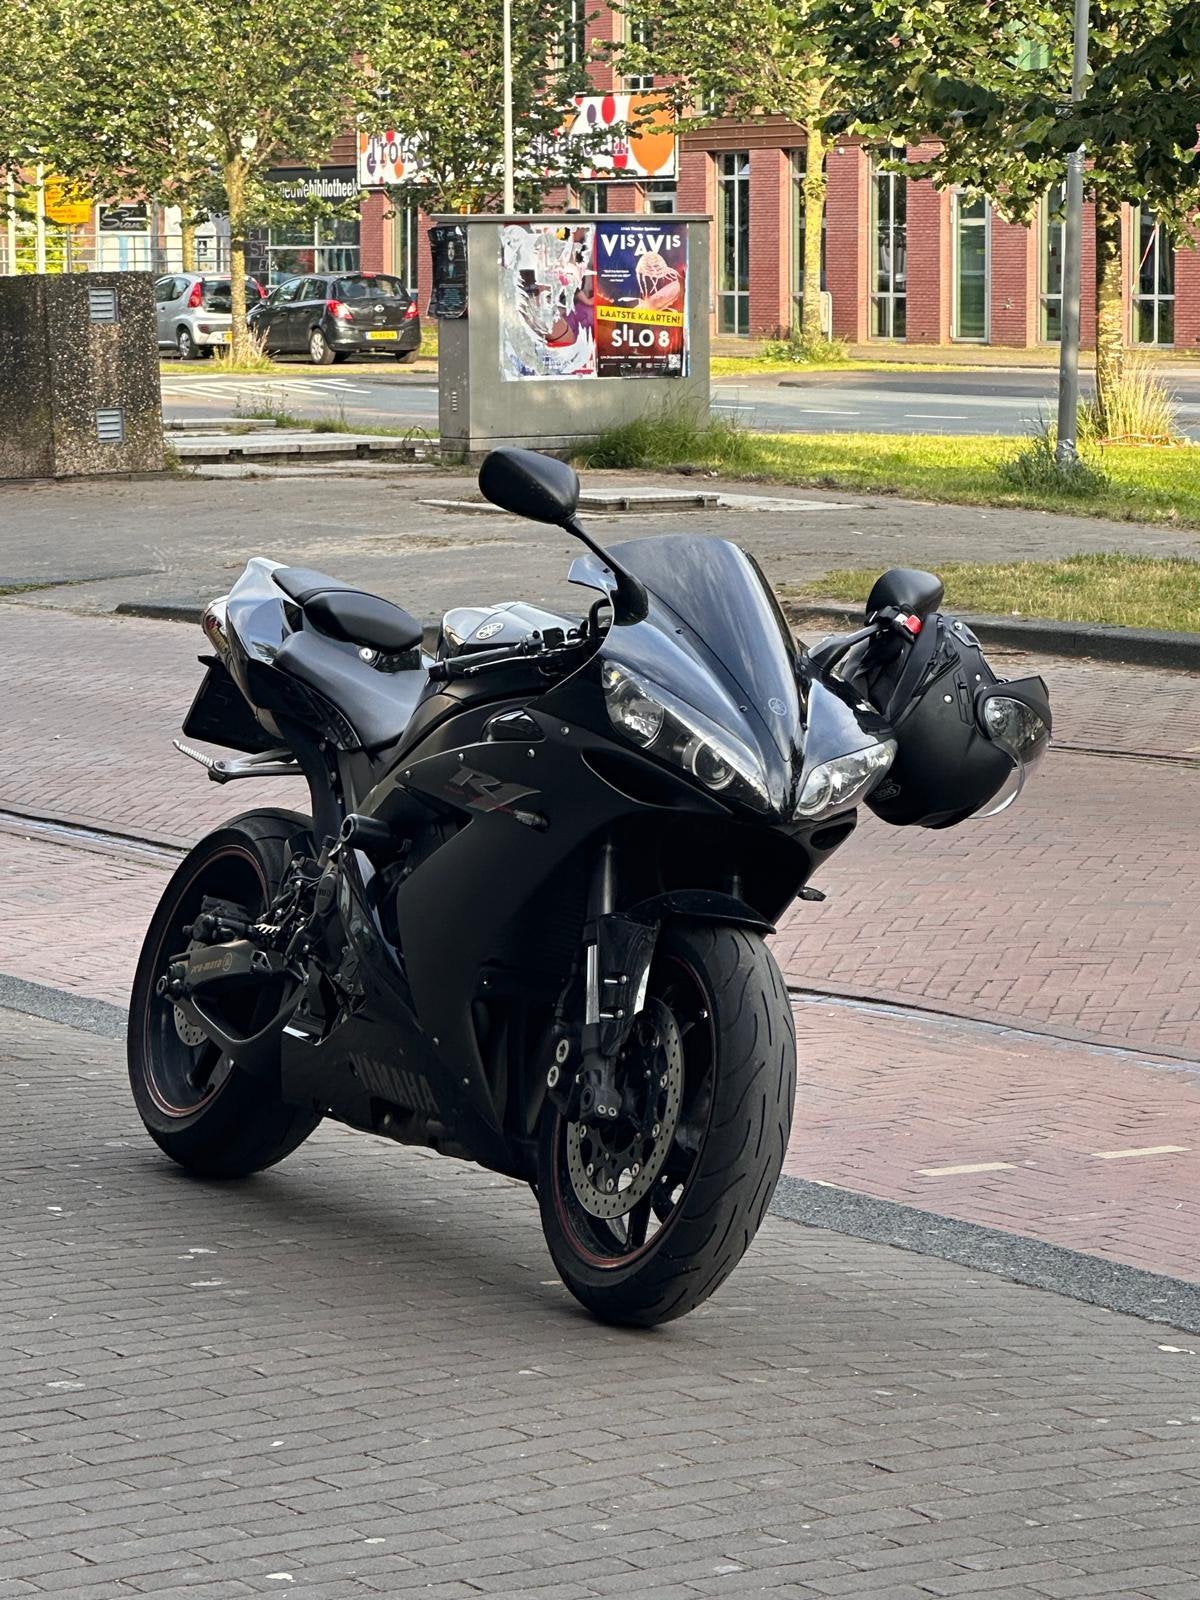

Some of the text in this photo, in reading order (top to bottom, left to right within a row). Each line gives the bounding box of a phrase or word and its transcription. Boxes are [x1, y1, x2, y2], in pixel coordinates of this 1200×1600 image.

[600, 309, 681, 324] LAATSTE KAARTEN!
[611, 324, 670, 348] SILO 8
